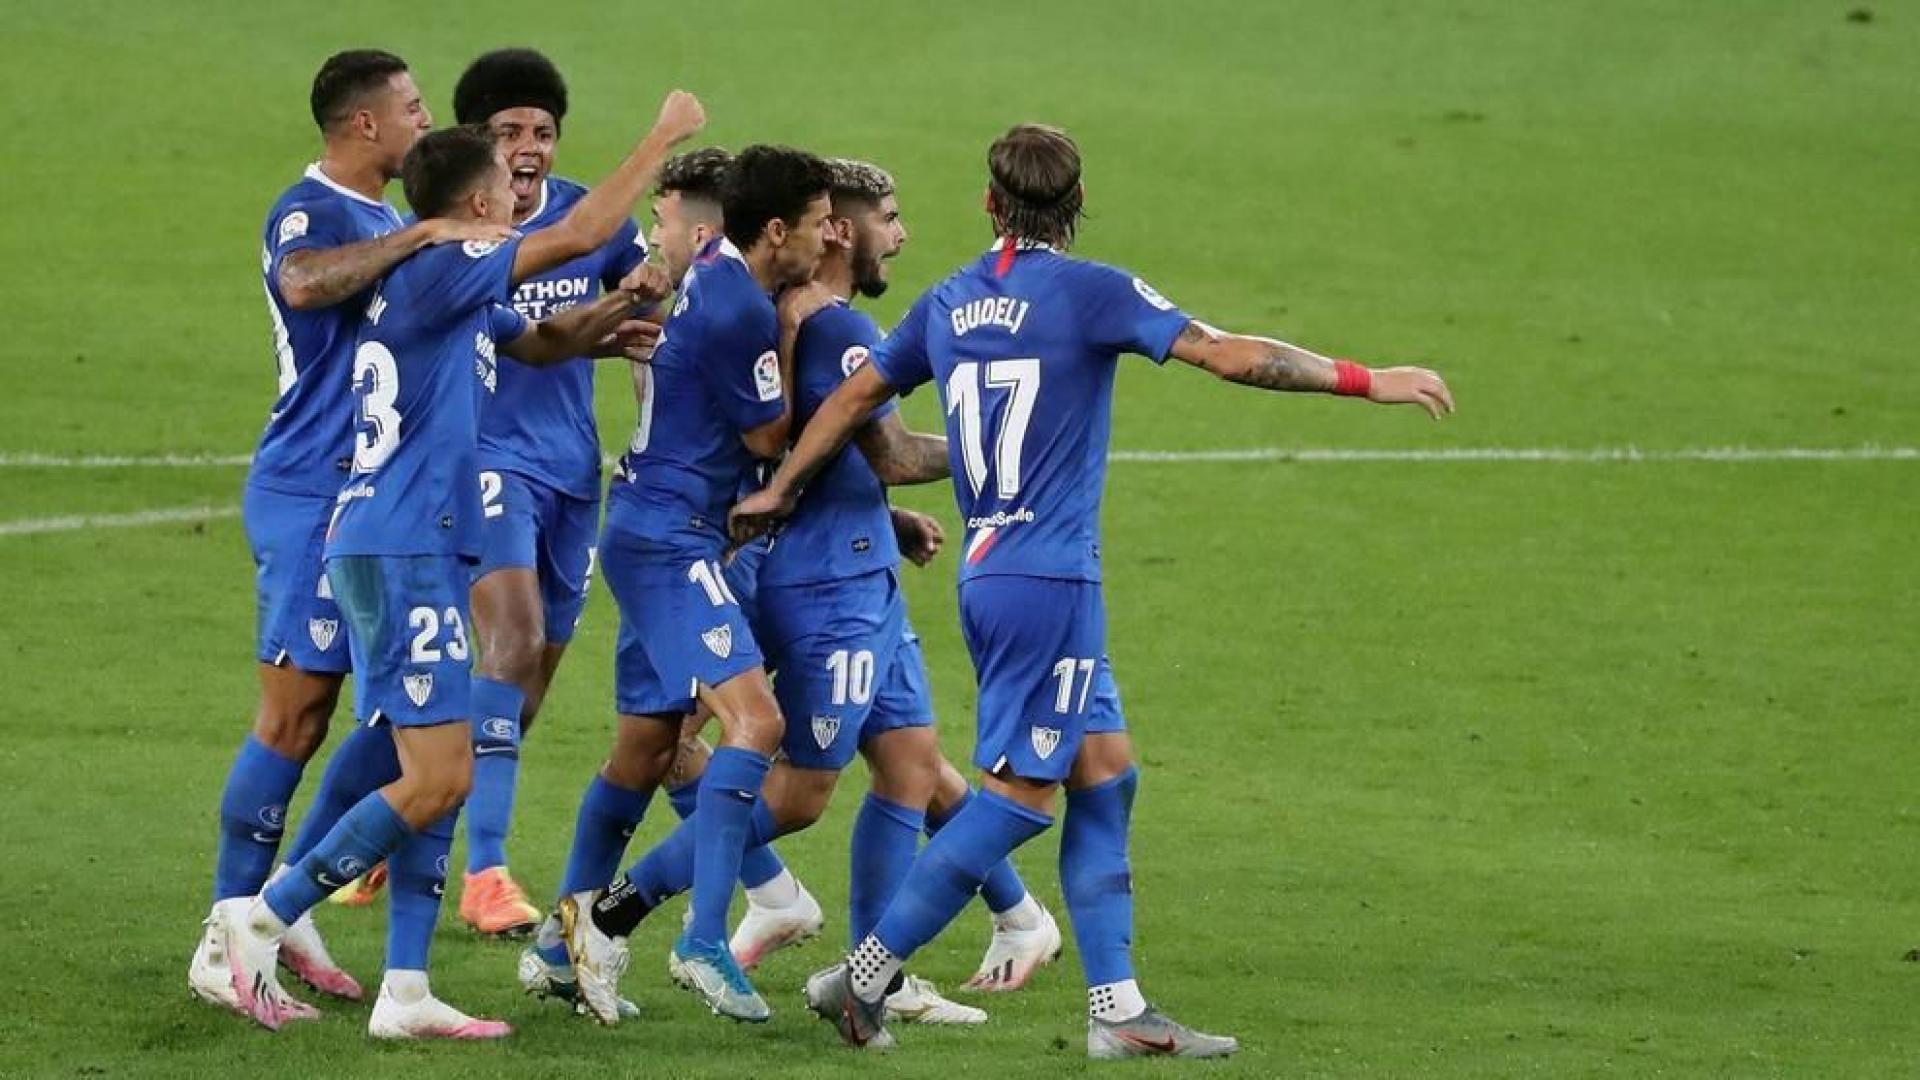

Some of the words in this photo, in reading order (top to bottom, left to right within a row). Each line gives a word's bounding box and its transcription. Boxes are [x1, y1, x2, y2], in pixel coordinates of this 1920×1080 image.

[952, 297, 1030, 336] GUDELJ
[946, 358, 1041, 500] 17
[480, 471, 503, 517] 2
[408, 606, 468, 663] 23
[825, 650, 874, 705] 10
[1053, 657, 1095, 714] 17
